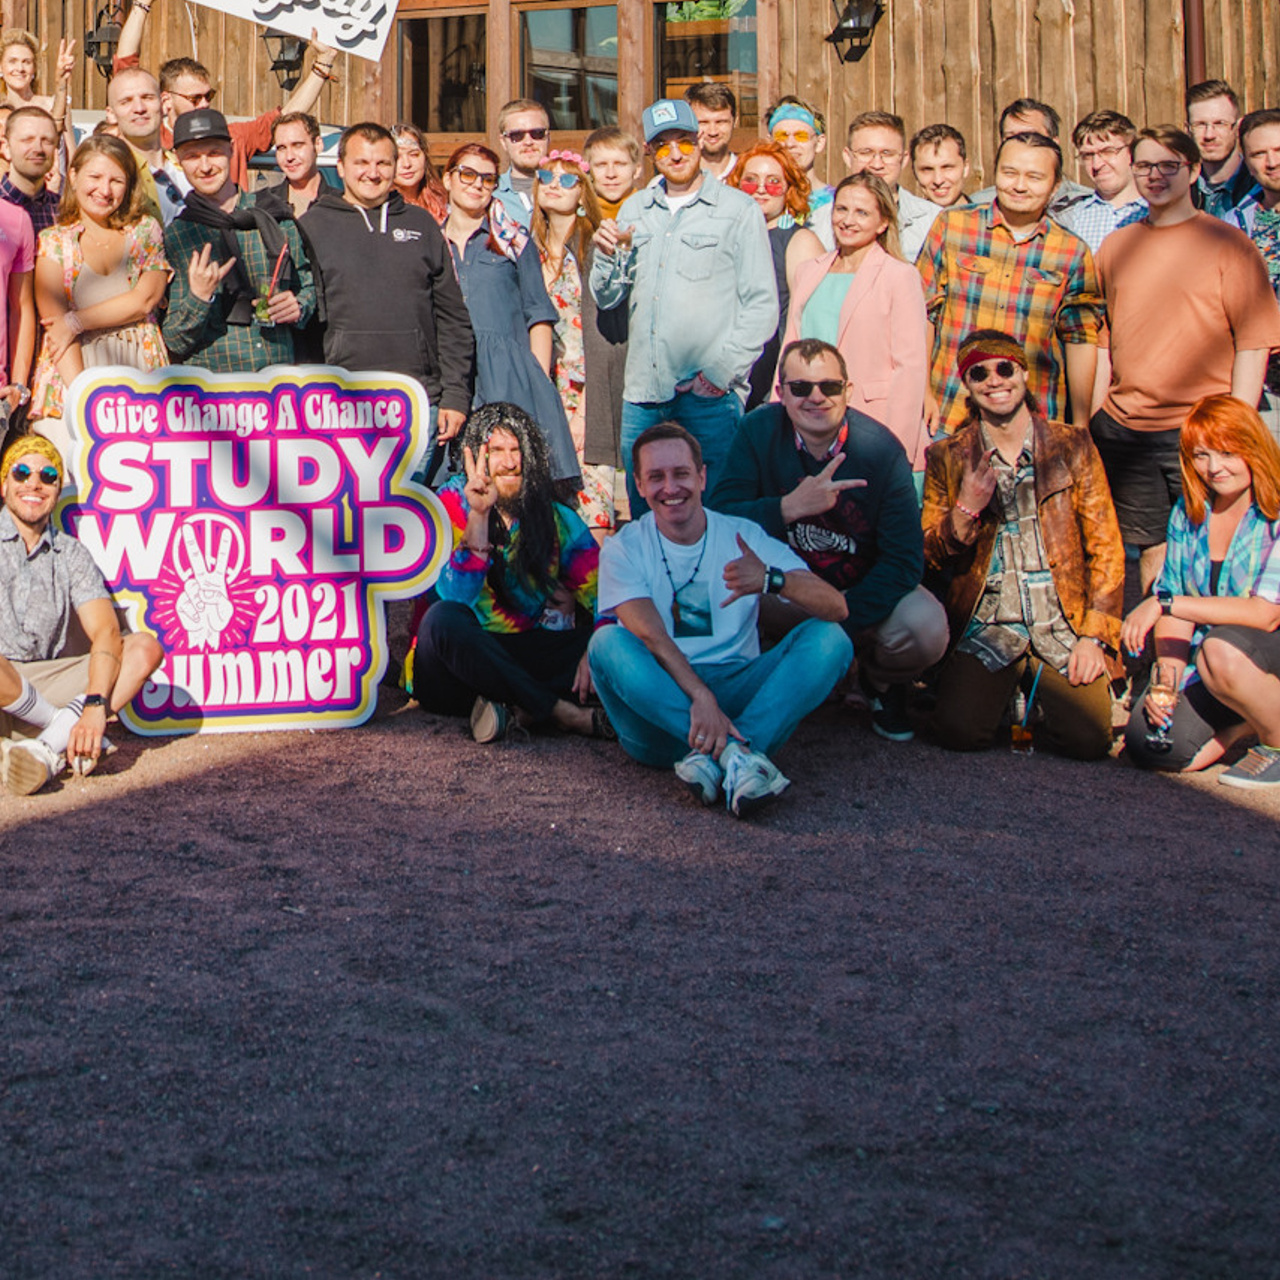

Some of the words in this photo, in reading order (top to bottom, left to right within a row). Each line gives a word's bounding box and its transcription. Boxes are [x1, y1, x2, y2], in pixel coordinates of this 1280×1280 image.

[97, 398, 158, 434] Give
[167, 396, 269, 437] Change
[277, 394, 299, 430] A
[305, 394, 402, 430] Chance
[98, 437, 399, 510] STUDY
[253, 583, 360, 643] 2021
